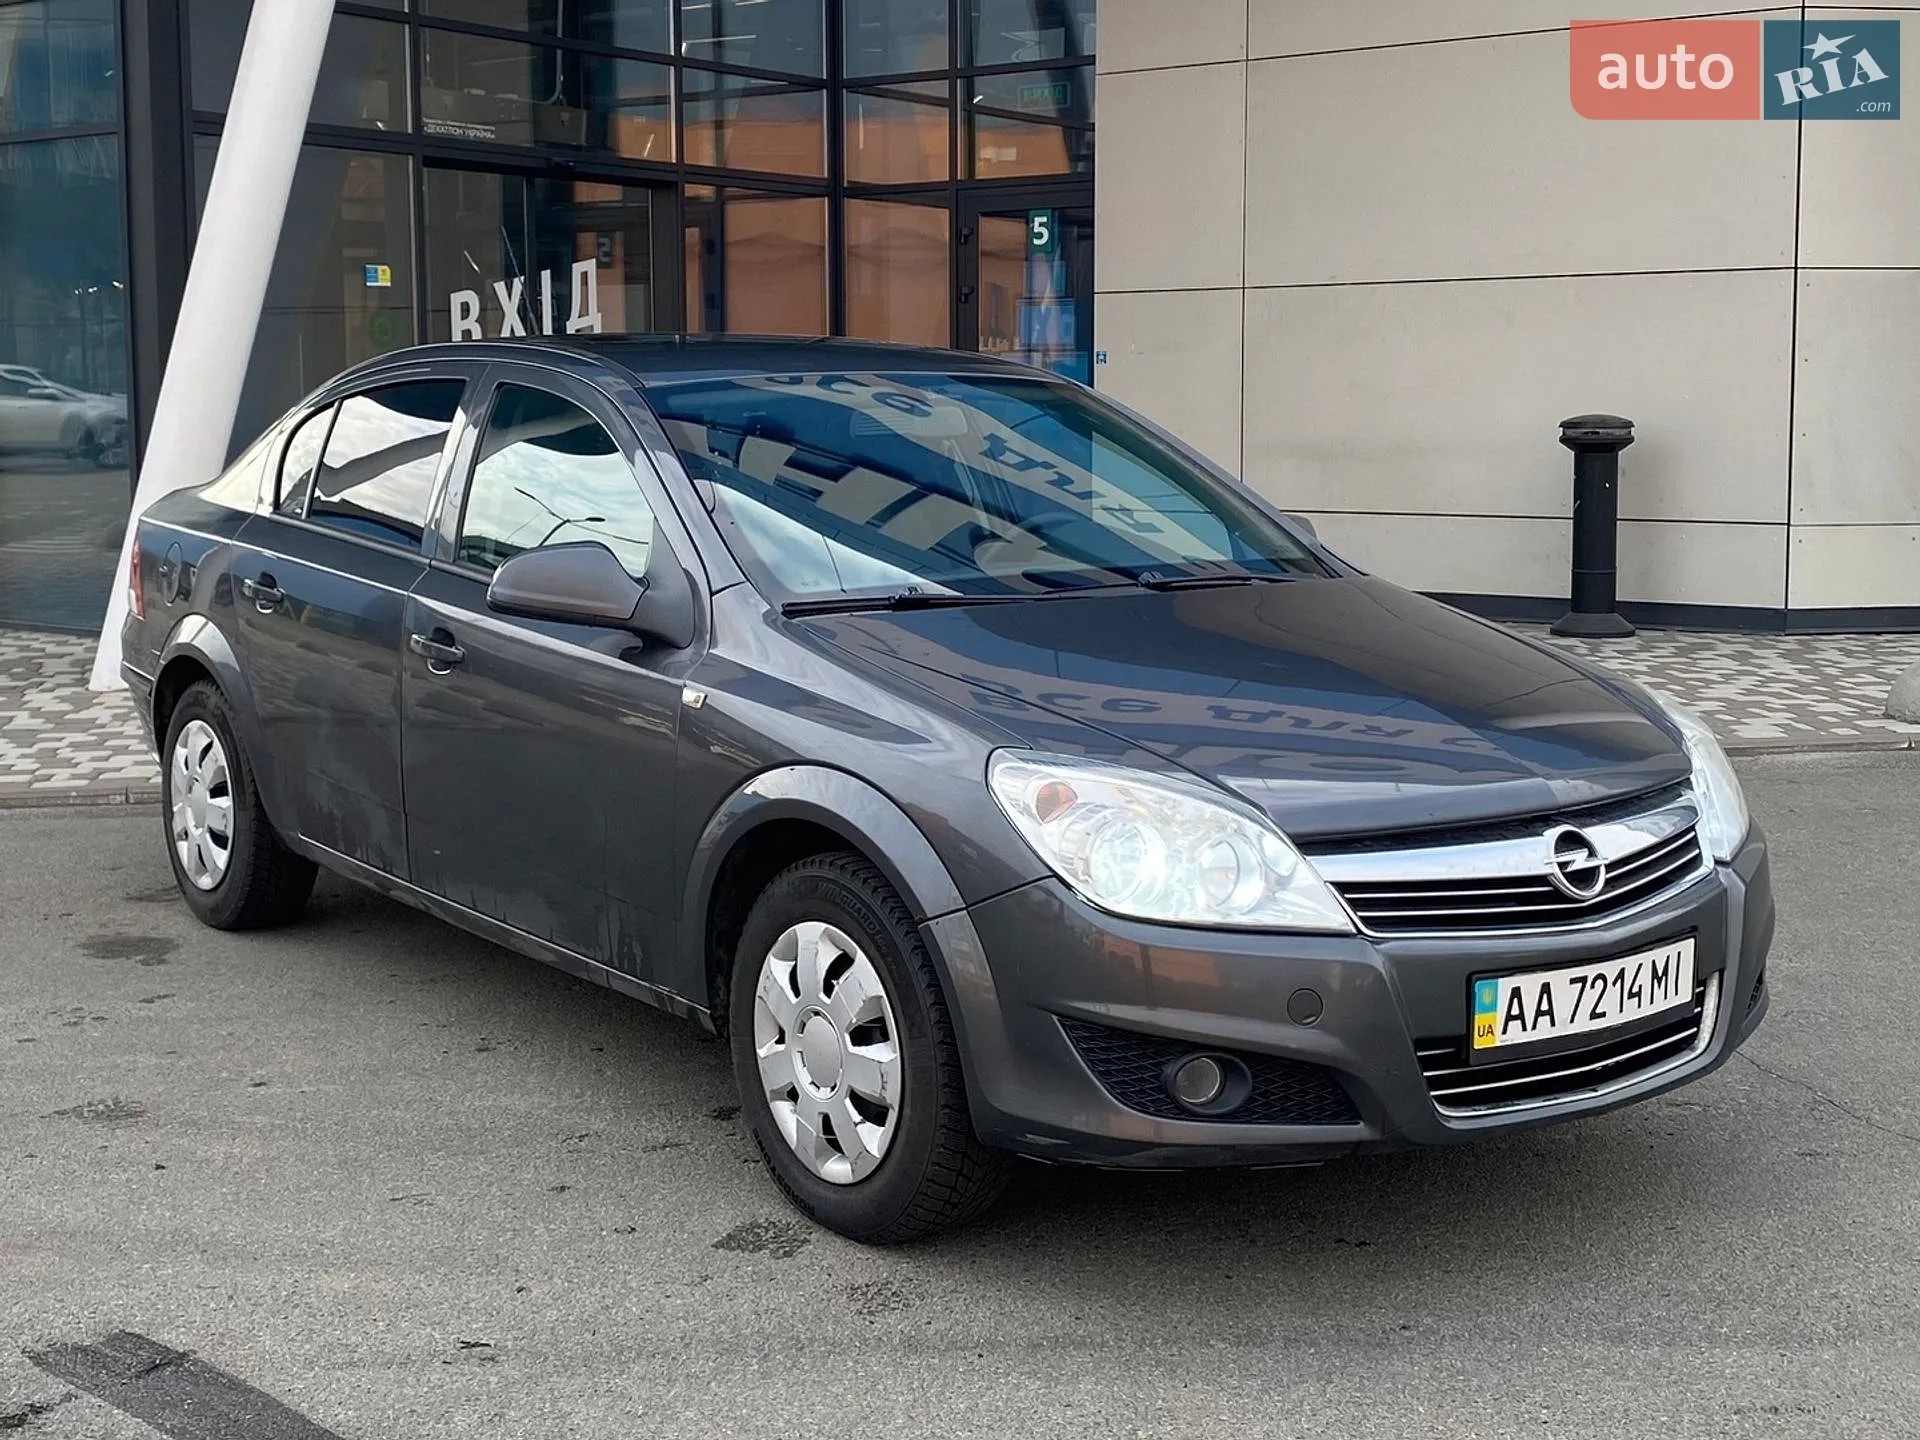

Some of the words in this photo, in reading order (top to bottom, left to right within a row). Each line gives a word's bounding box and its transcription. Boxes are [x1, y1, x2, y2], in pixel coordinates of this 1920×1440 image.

[1033, 216, 1050, 246] 5
[450, 258, 602, 342] ВХІД
[1477, 1023, 1495, 1038] UA
